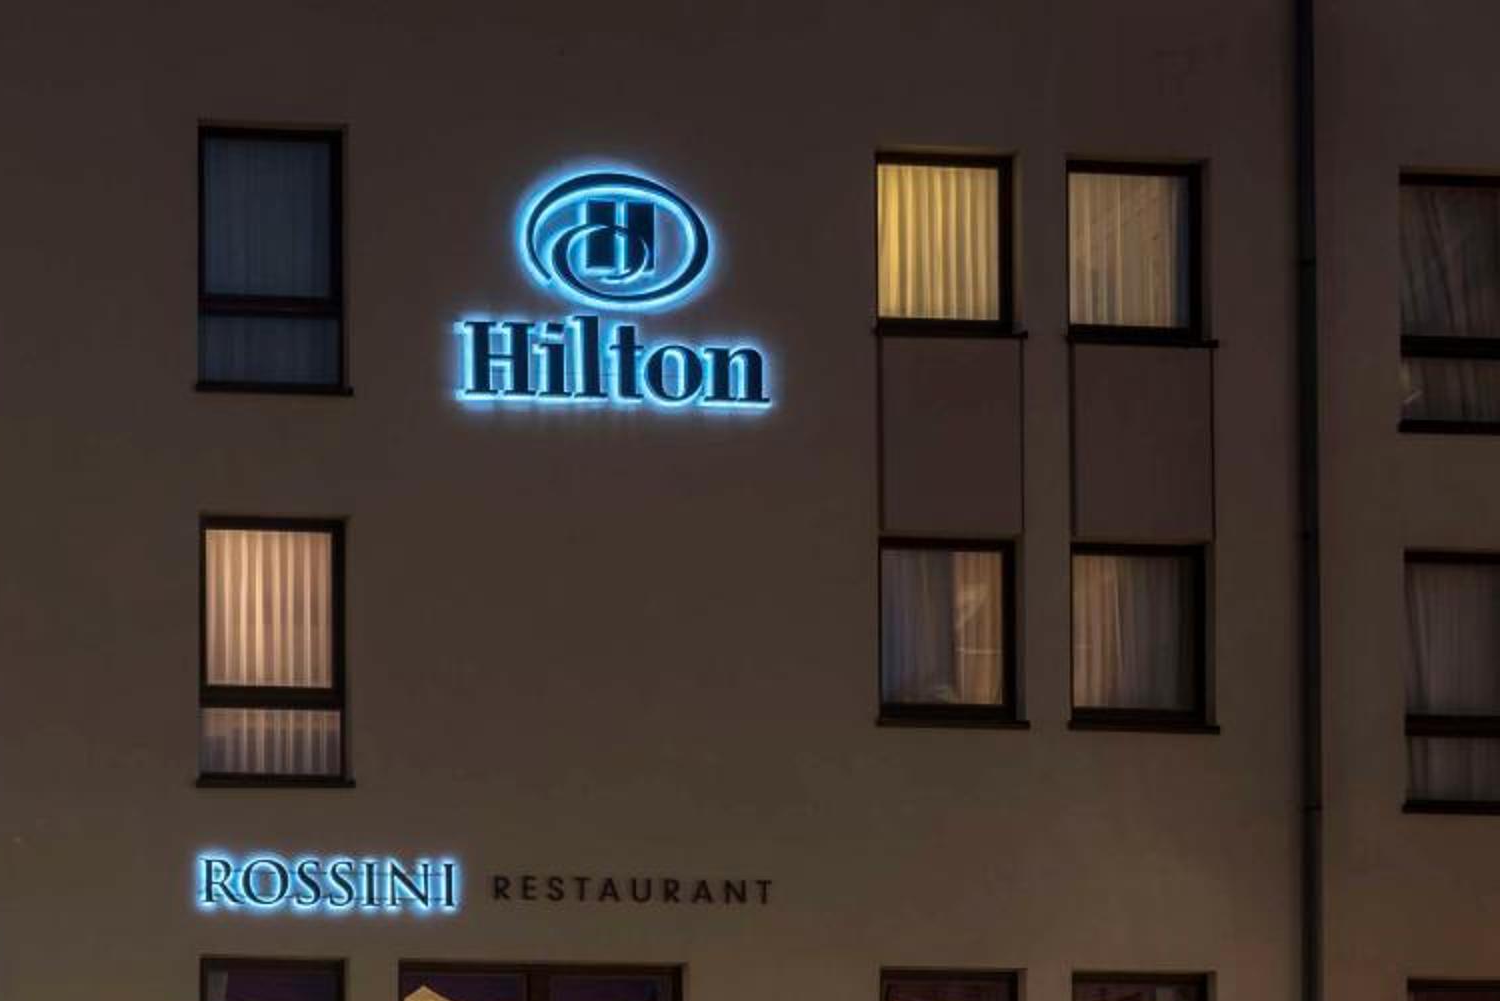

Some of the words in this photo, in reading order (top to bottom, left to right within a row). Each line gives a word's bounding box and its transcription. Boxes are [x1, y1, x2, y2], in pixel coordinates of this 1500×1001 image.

[457, 315, 771, 406] Hilton
[199, 856, 457, 909] ROSSINI
[491, 874, 773, 905] RESTAURANT
